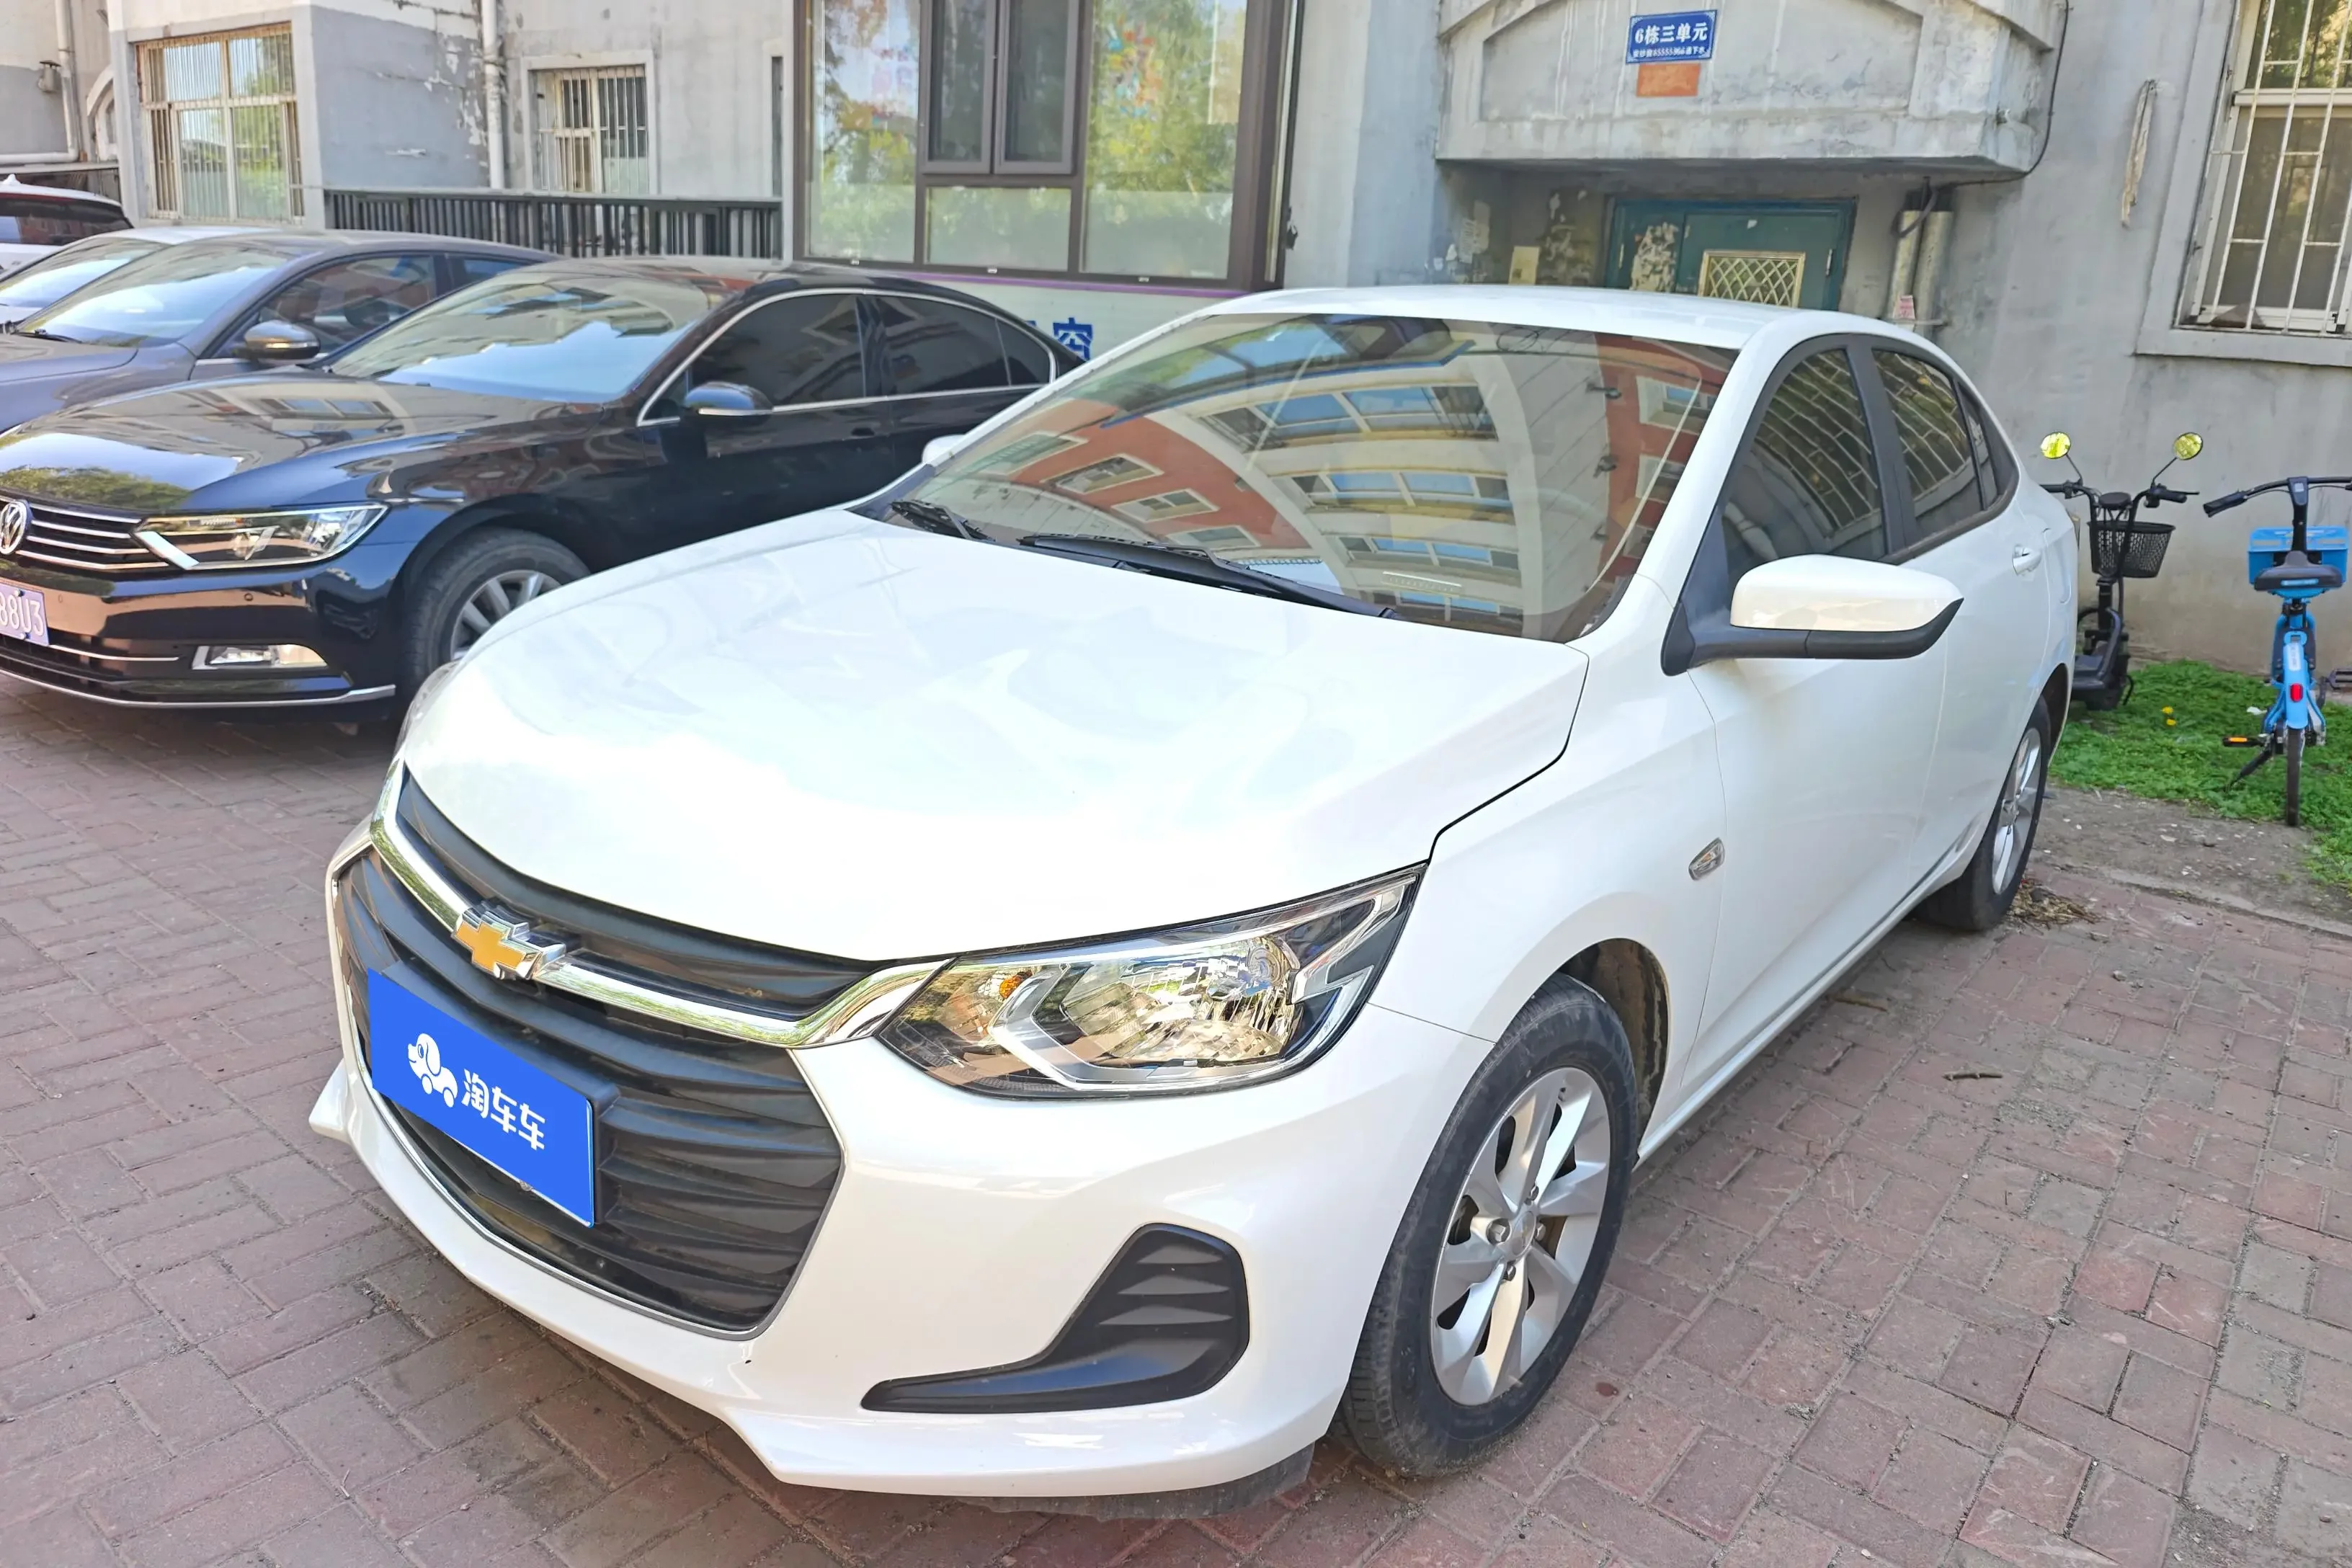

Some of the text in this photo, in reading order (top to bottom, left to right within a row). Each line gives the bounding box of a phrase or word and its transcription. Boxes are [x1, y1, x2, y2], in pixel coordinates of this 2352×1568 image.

[1634, 22, 1708, 45] 6栋三单元
[1025, 317, 1093, 360] 窗
